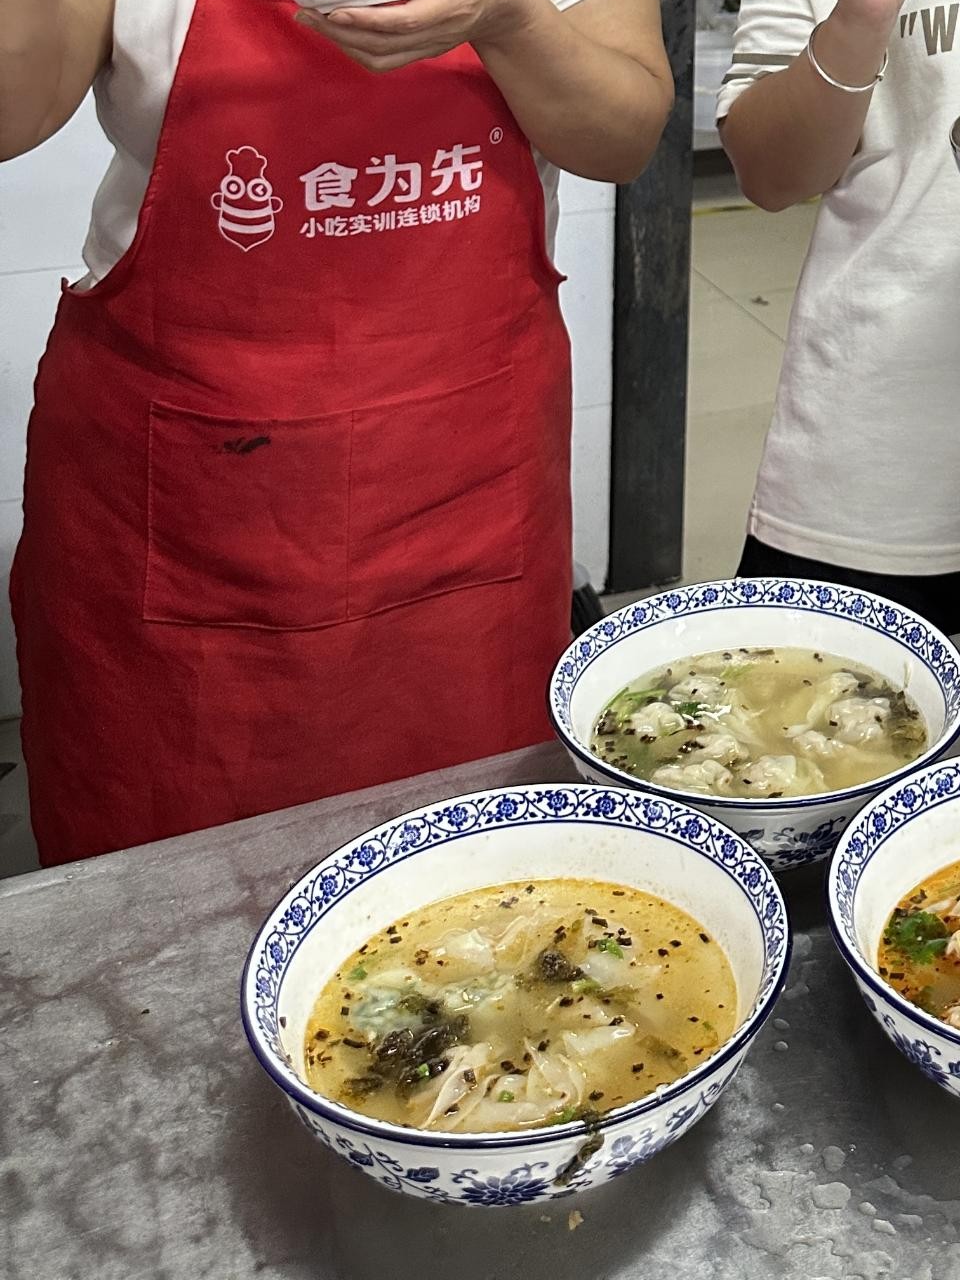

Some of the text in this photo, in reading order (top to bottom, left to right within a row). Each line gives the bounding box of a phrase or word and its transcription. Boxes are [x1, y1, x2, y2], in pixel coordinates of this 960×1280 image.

[299, 143, 484, 212] 食为先
[300, 194, 481, 238] 小吃实训连锁机构
